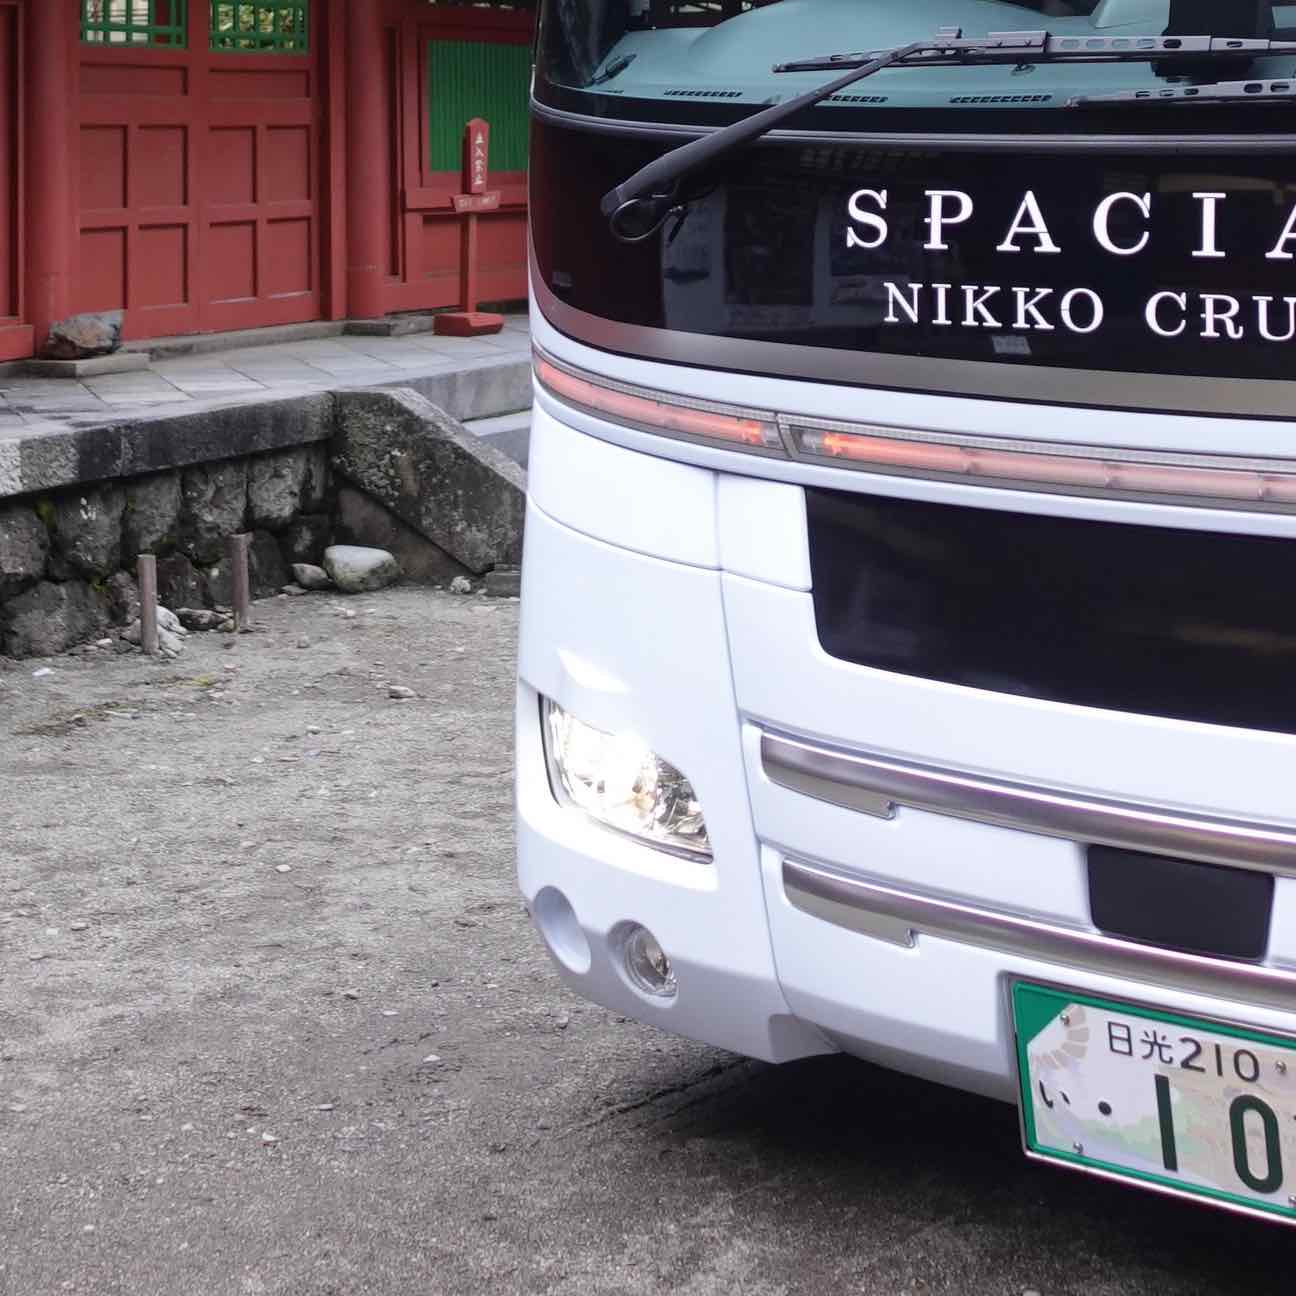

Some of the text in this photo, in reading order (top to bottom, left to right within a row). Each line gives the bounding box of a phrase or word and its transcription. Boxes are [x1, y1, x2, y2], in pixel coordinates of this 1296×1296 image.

[883, 283, 1104, 333] NIKKO
[1107, 1021, 1260, 1082] 日光210
[1039, 1080, 1071, 1108] い
